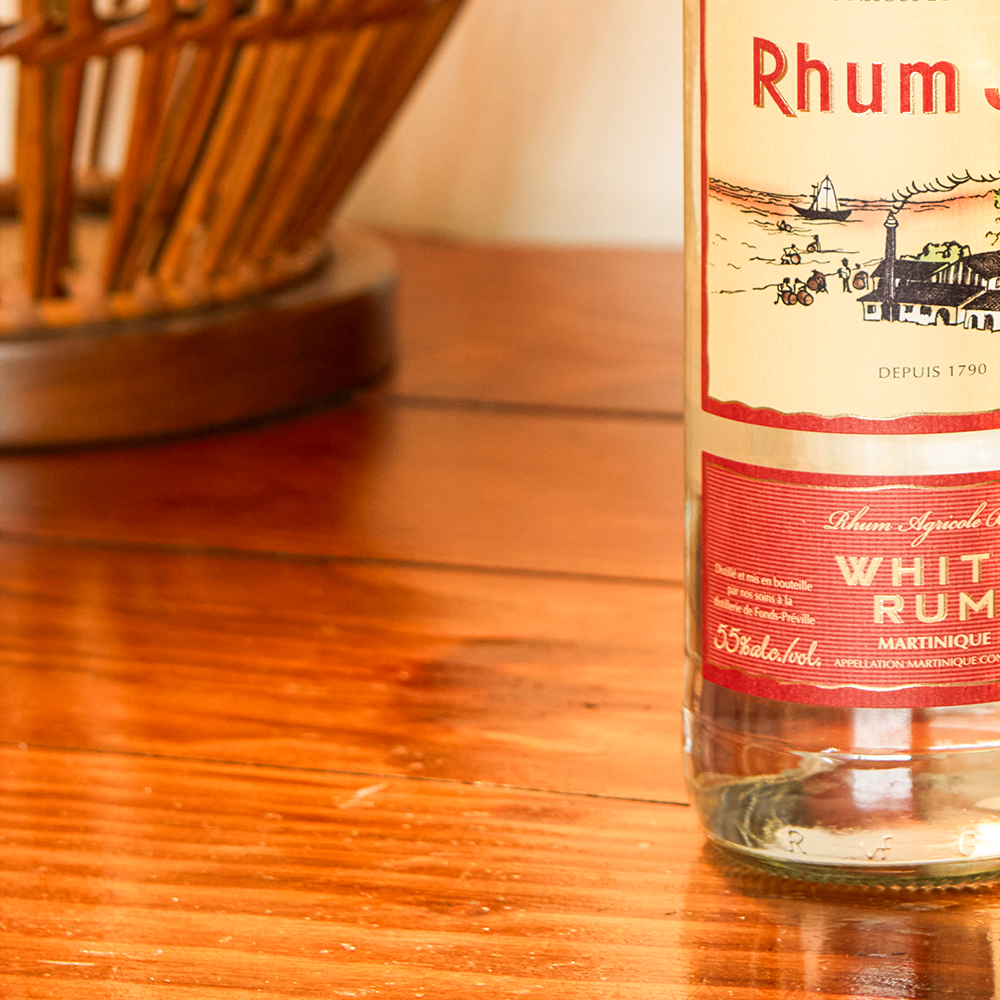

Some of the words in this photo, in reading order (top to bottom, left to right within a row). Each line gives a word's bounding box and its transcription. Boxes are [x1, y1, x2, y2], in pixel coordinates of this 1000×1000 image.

[753, 36, 960, 118] Rhum
[879, 365, 941, 379] DEPUIS
[948, 363, 987, 377] 1790
[823, 506, 893, 532] Rhum
[898, 501, 988, 547] Agricole
[761, 577, 772, 586] en
[773, 576, 813, 591] bouteille
[740, 589, 753, 599] nos
[755, 592, 775, 604] soins
[777, 594, 782, 604] à
[785, 594, 793, 606] la
[873, 588, 997, 624] RUM
[743, 605, 753, 616] de
[754, 607, 816, 625] Fonds-Préville
[878, 632, 991, 650] MARTINIQUE
[834, 657, 904, 669] APPELLATION
[907, 656, 977, 668] MARTINIQUE
